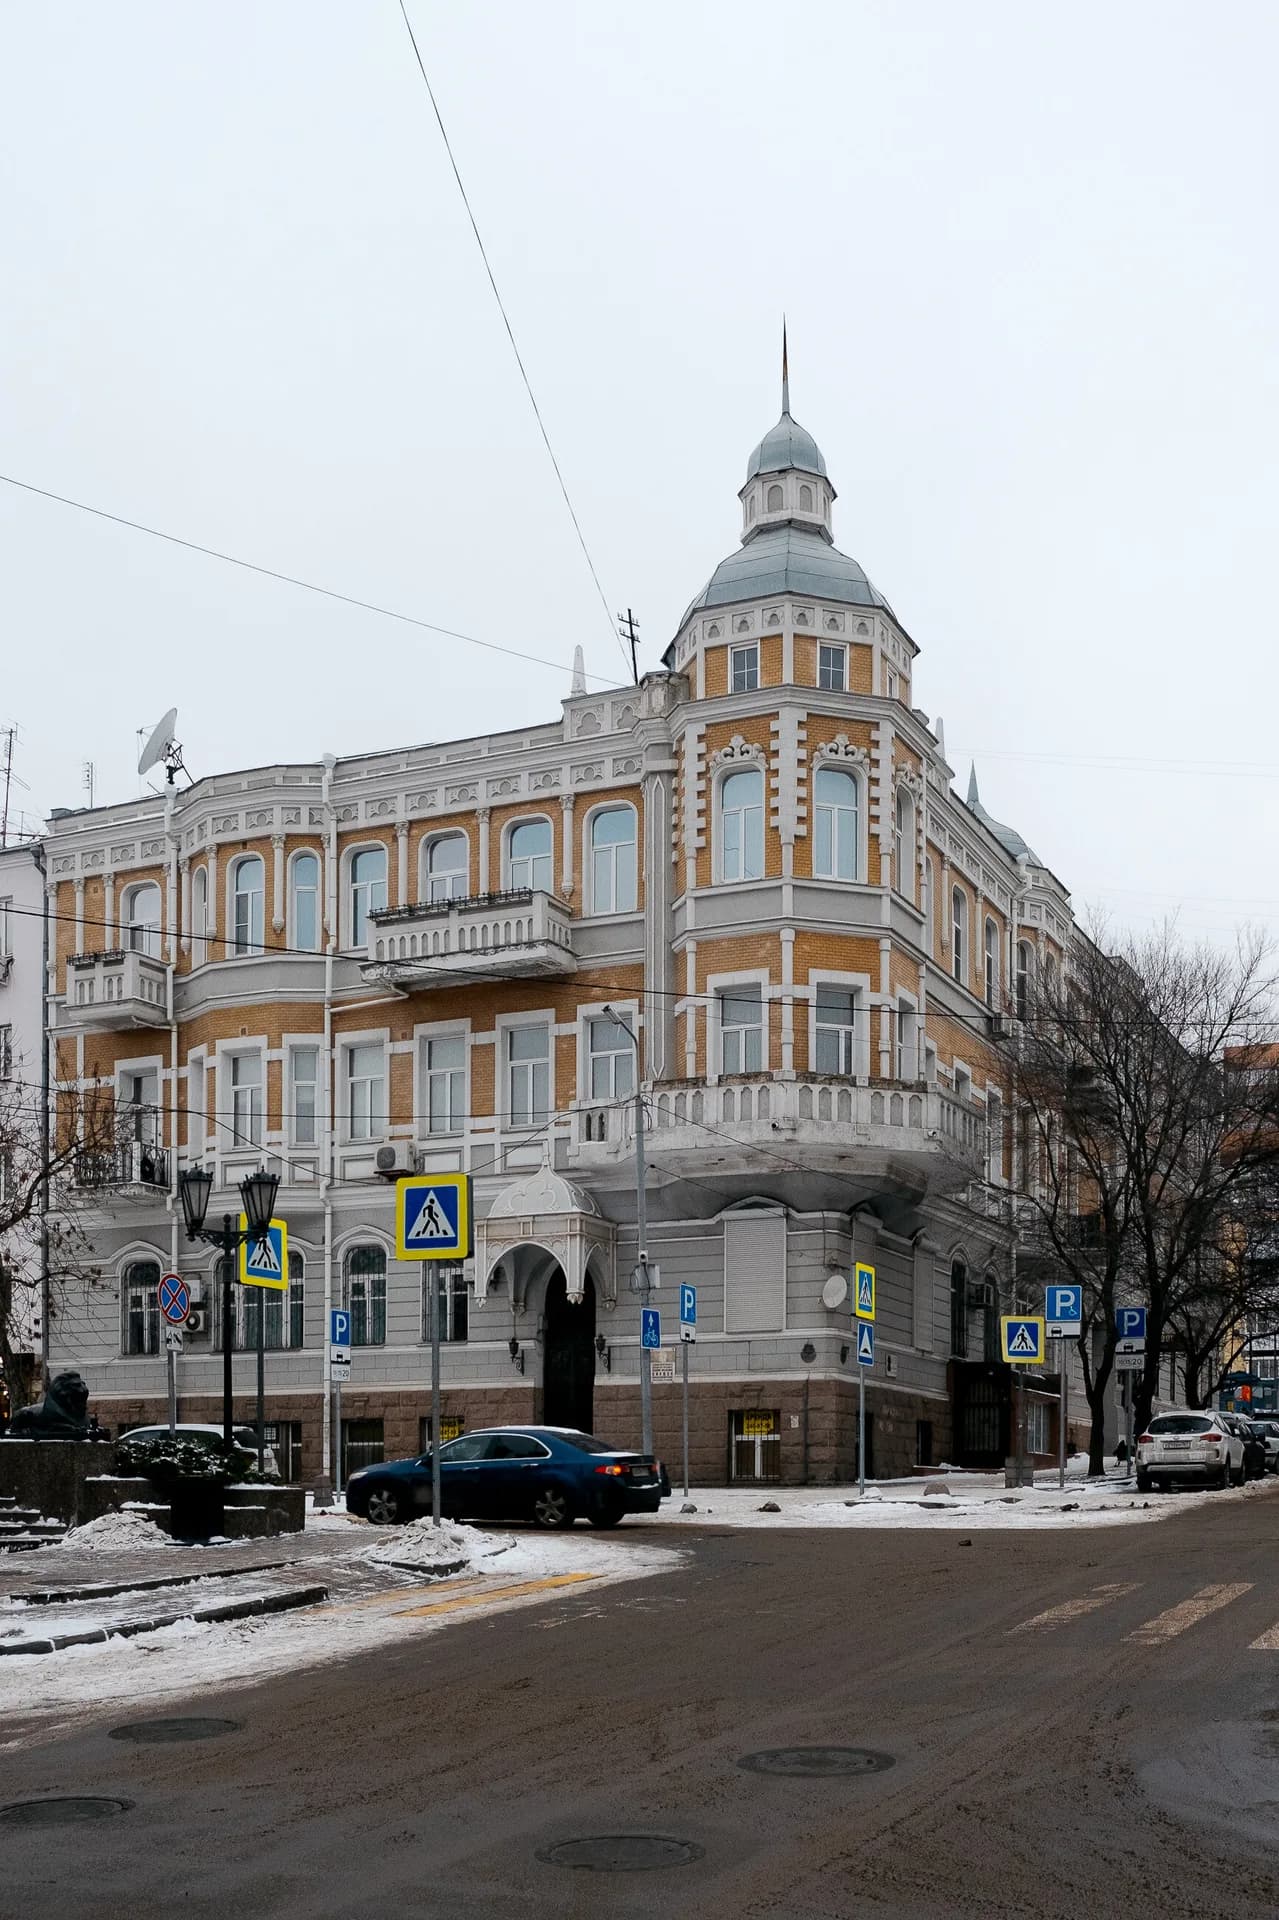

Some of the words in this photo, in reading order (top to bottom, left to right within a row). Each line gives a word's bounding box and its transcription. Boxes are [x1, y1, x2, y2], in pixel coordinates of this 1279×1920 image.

[685, 1289, 694, 1318] P
[1056, 1290, 1075, 1317] P
[336, 1314, 347, 1341] P
[1123, 1311, 1140, 1335] P
